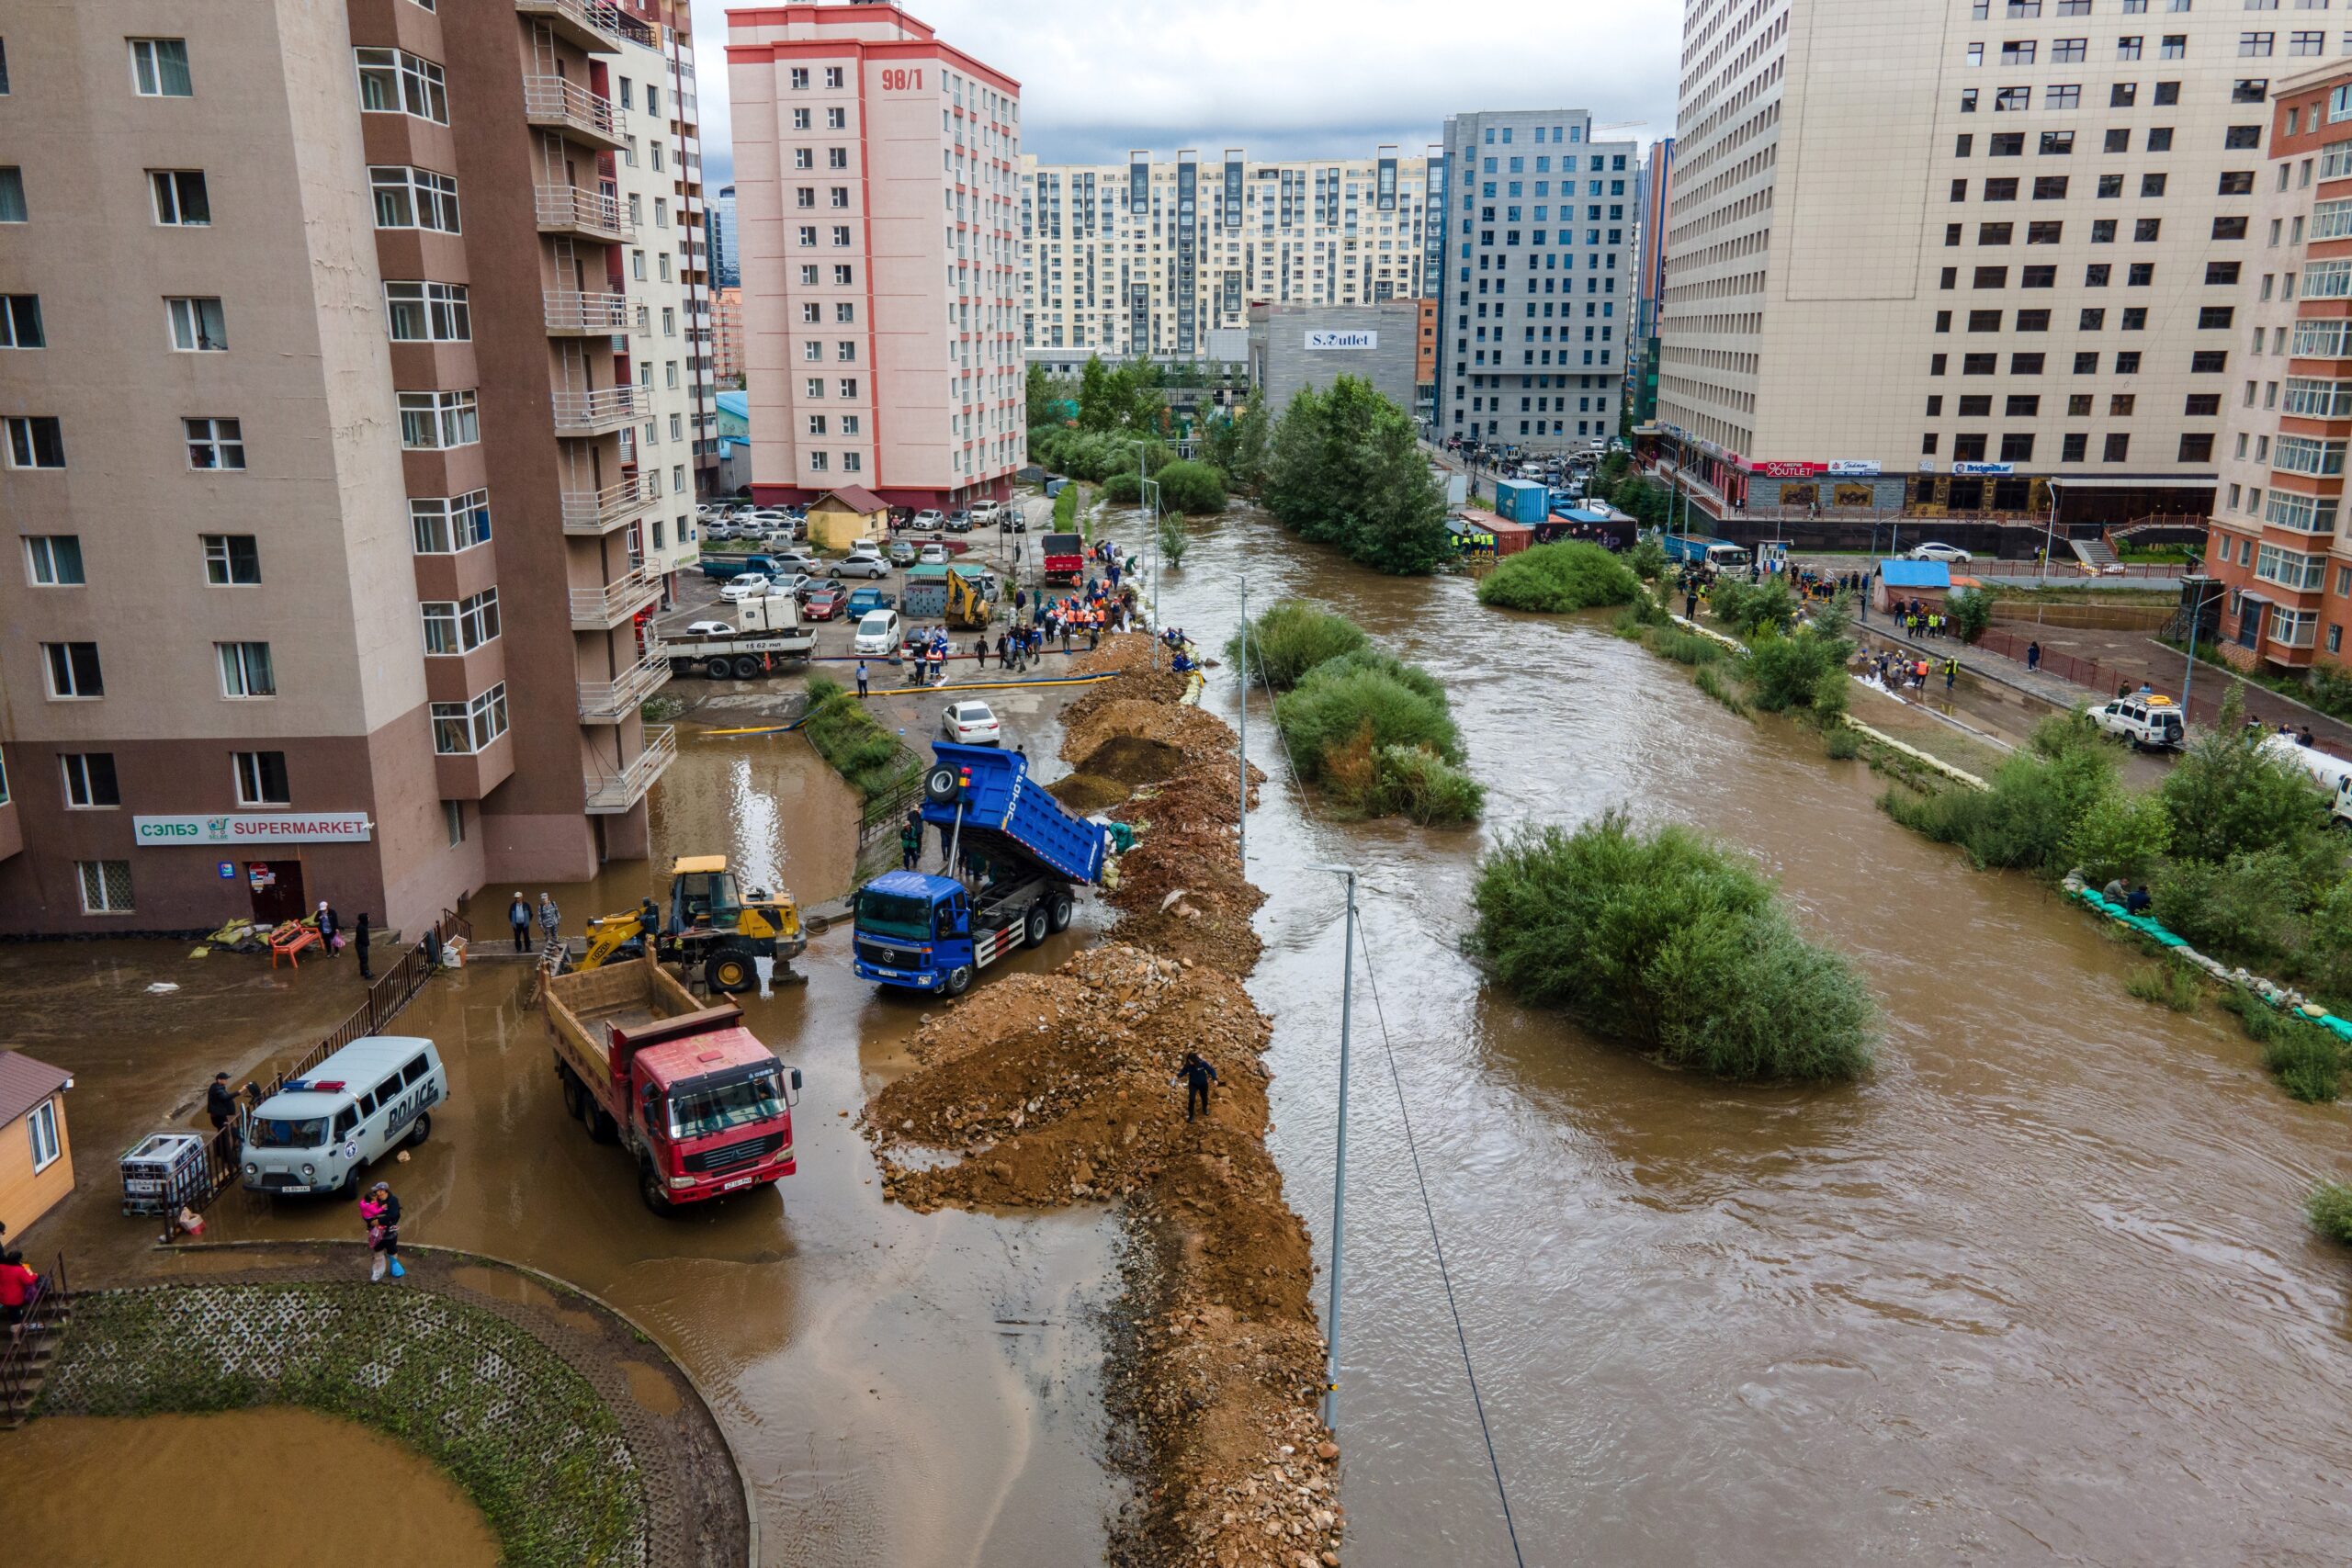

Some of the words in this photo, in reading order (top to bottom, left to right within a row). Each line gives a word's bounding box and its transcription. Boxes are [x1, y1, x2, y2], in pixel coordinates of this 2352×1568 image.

[882, 69, 922, 90] 98/1
[141, 823, 199, 837] СЭЛБЭ
[233, 821, 365, 835] SUPERMARKET
[388, 1077, 435, 1134] POLICE
